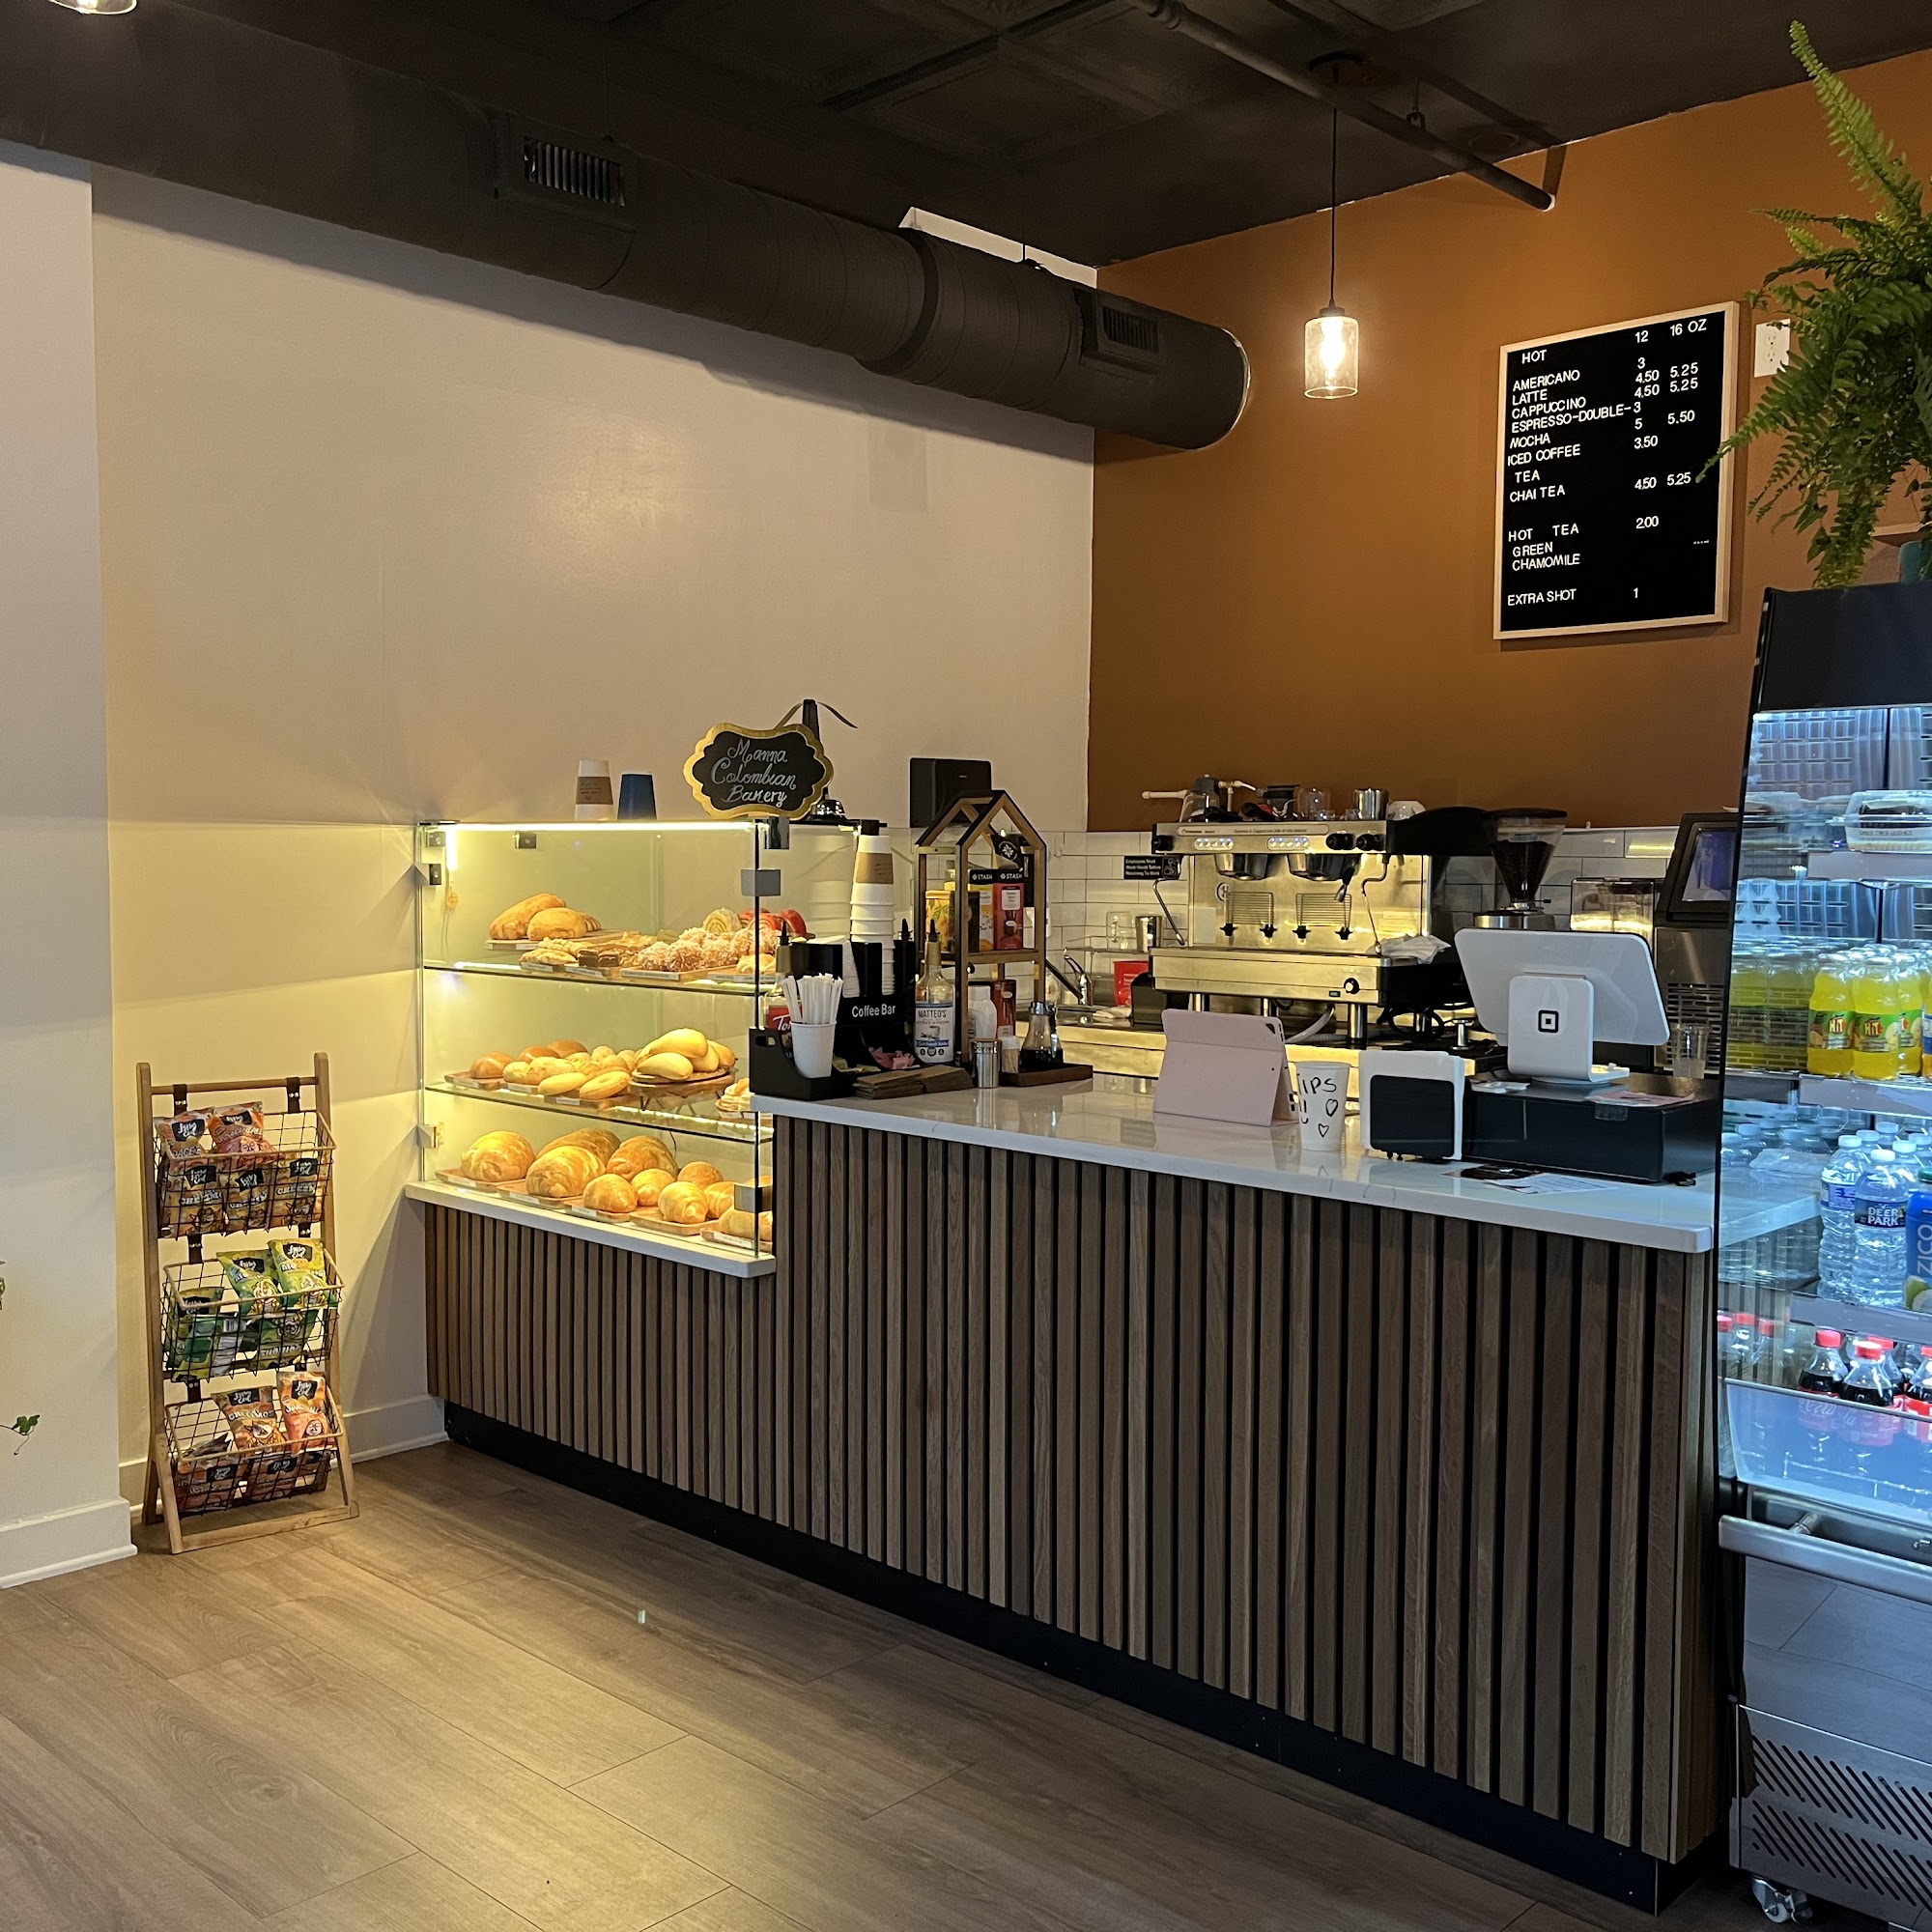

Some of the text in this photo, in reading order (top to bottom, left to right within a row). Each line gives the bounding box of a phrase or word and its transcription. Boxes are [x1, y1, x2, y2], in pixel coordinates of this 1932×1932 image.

[1521, 318, 1708, 364] HOT 12 16 OZ
[1512, 356, 1646, 392] AMERICANO 3
[1512, 361, 1699, 407] LATTE 4.50 5.25
[1511, 377, 1699, 420] CAPPUCCINO 4.50 5.25
[1509, 409, 1696, 449] MOCHA 5 5.50
[1507, 435, 1659, 467] ICED COFFEE 3.50
[1514, 469, 1541, 484] TEA
[1509, 488, 1538, 503] CHAI
[1539, 484, 1566, 498] TEA
[1508, 527, 1534, 543] HOT
[1551, 523, 1579, 537] TEA
[1512, 541, 1553, 558] GREEN
[1512, 553, 1581, 572] CHAMOMILE
[1507, 586, 1639, 607] EXTRA SHOT 1
[726, 737, 788, 768] Manna
[710, 756, 797, 791] Colombian
[721, 783, 788, 809] Bakery
[851, 1003, 896, 1018] Coffee Bar
[918, 1009, 947, 1018] MATTEO'S
[1867, 1207, 1899, 1217] DEER
[1867, 1216, 1899, 1227] PARK
[1917, 1224, 1932, 1275] ZICO
